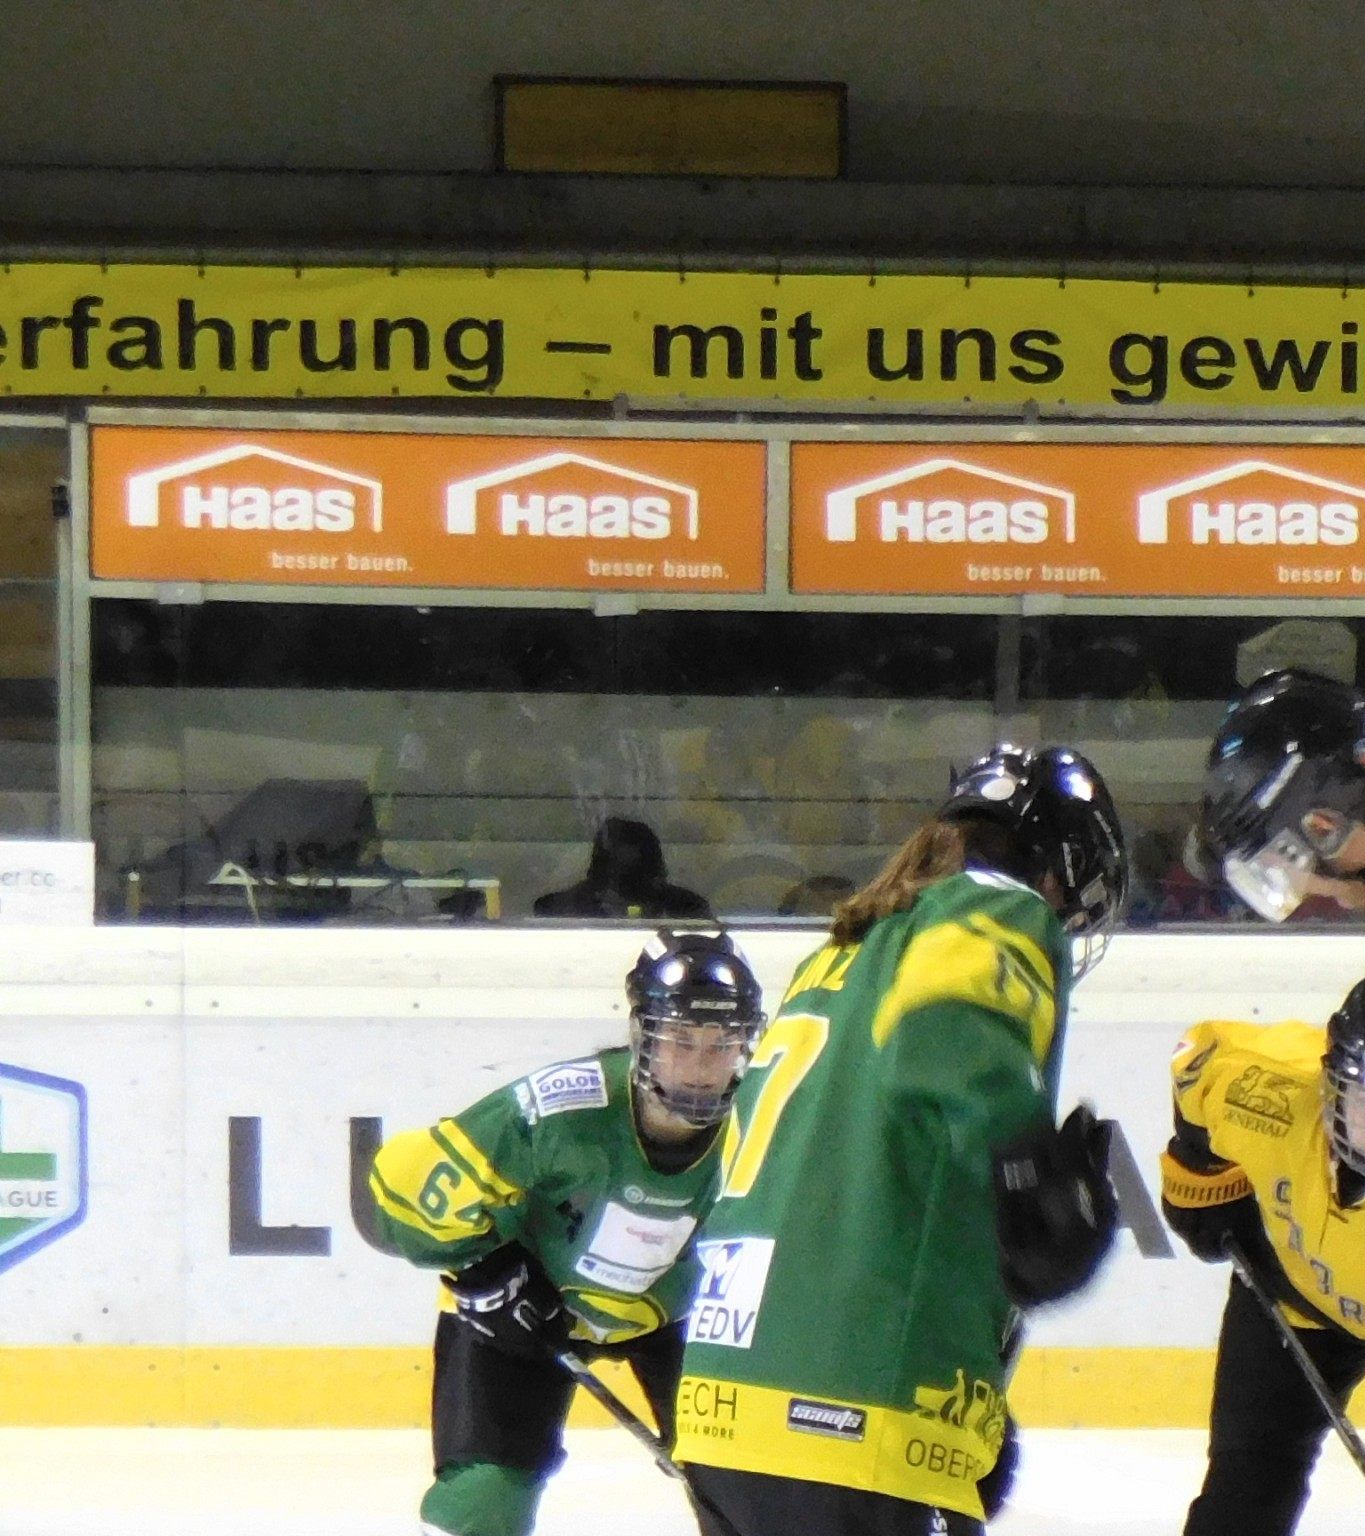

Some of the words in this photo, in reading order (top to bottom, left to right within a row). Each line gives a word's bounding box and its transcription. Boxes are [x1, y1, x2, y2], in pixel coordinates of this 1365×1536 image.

[0, 295, 505, 393] rfahrung
[653, 308, 824, 384] mit
[866, 327, 1066, 384] uns
[183, 484, 356, 533] Haas
[498, 491, 673, 541] Haas
[879, 499, 1050, 545] Haas
[1191, 501, 1361, 547] Haas
[270, 552, 339, 570] besser
[346, 553, 412, 571] bauen.
[588, 559, 655, 577] besser
[663, 560, 729, 579] bauen.
[967, 564, 1034, 581] besser
[1041, 565, 1106, 582] bauen.
[1277, 565, 1342, 583] besser
[8, 1189, 58, 1208] GUE
